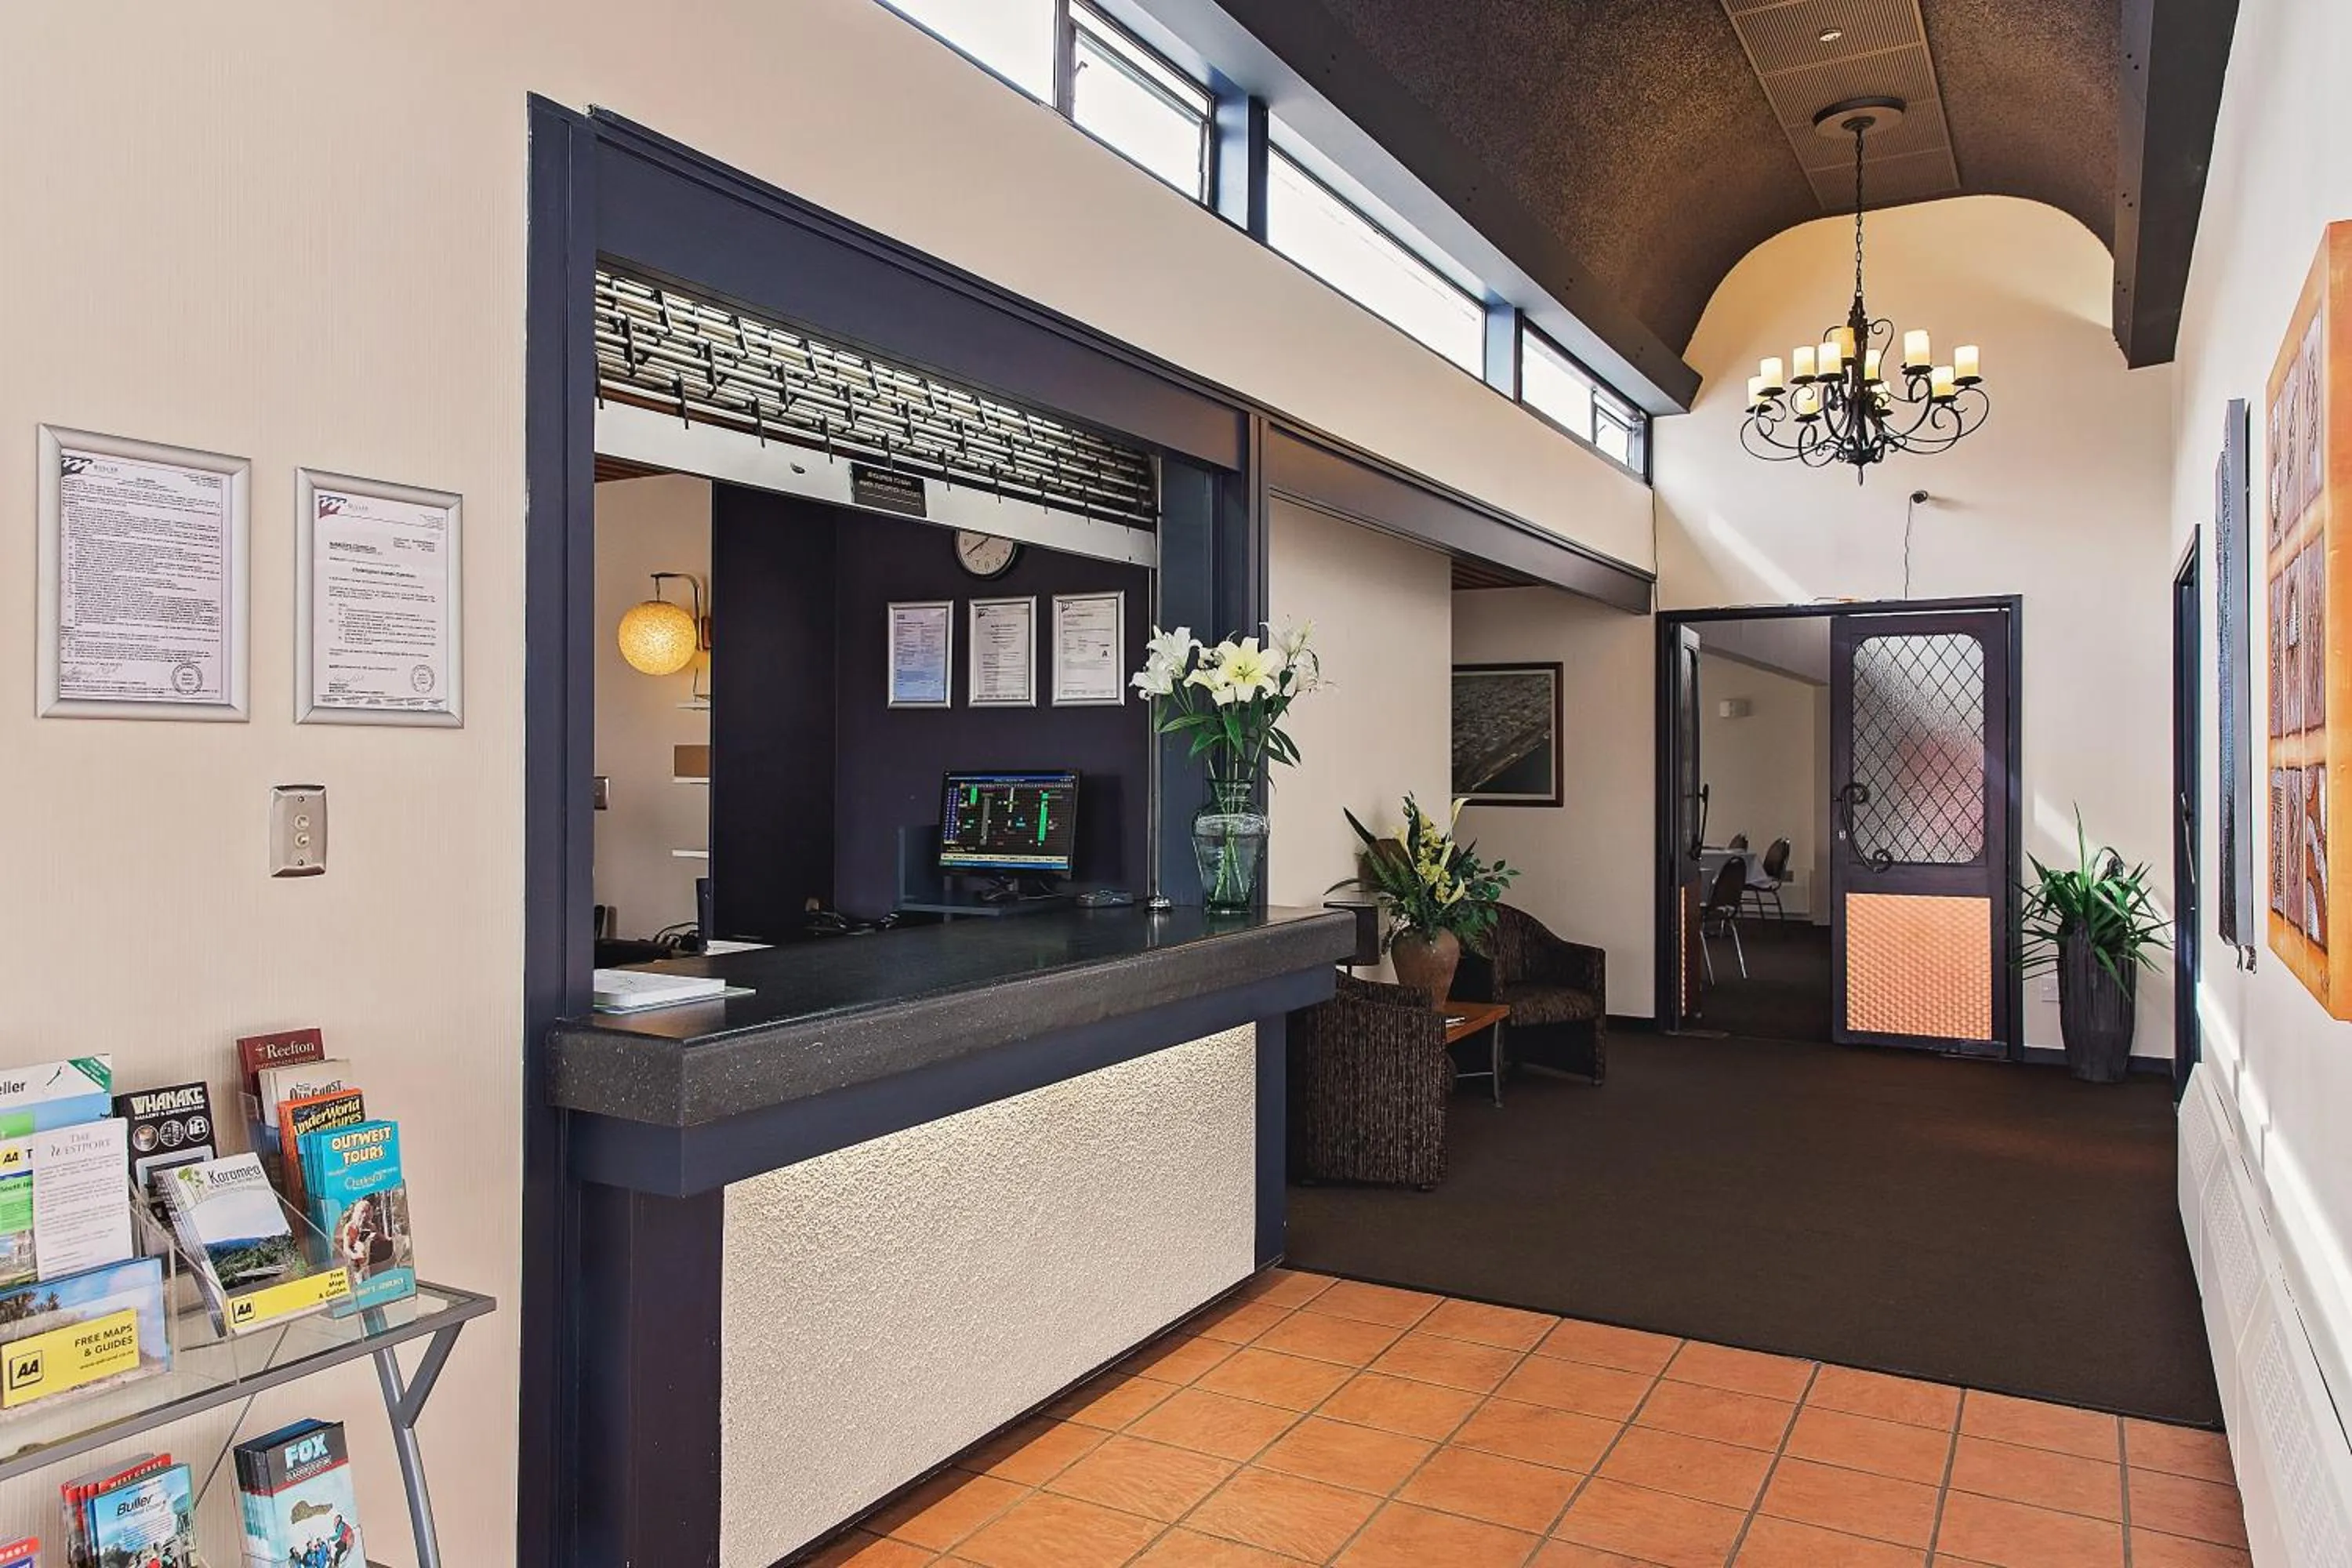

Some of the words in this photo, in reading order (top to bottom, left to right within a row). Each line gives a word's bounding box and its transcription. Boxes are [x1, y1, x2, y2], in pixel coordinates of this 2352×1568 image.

[131, 1087, 205, 1115] WHANAKE
[332, 1127, 391, 1151] OUTWEST
[2, 1152, 19, 1164] AA
[343, 1145, 384, 1166] TOURS
[208, 1164, 261, 1185] Karamea
[237, 1302, 252, 1316] AA
[74, 1333, 101, 1348] FREE
[103, 1323, 133, 1340] MAPS
[84, 1347, 92, 1357] &
[95, 1335, 133, 1354] GUIDES
[16, 1359, 39, 1379] AA
[285, 1432, 328, 1468] FOX
[117, 1494, 154, 1516] Buller
